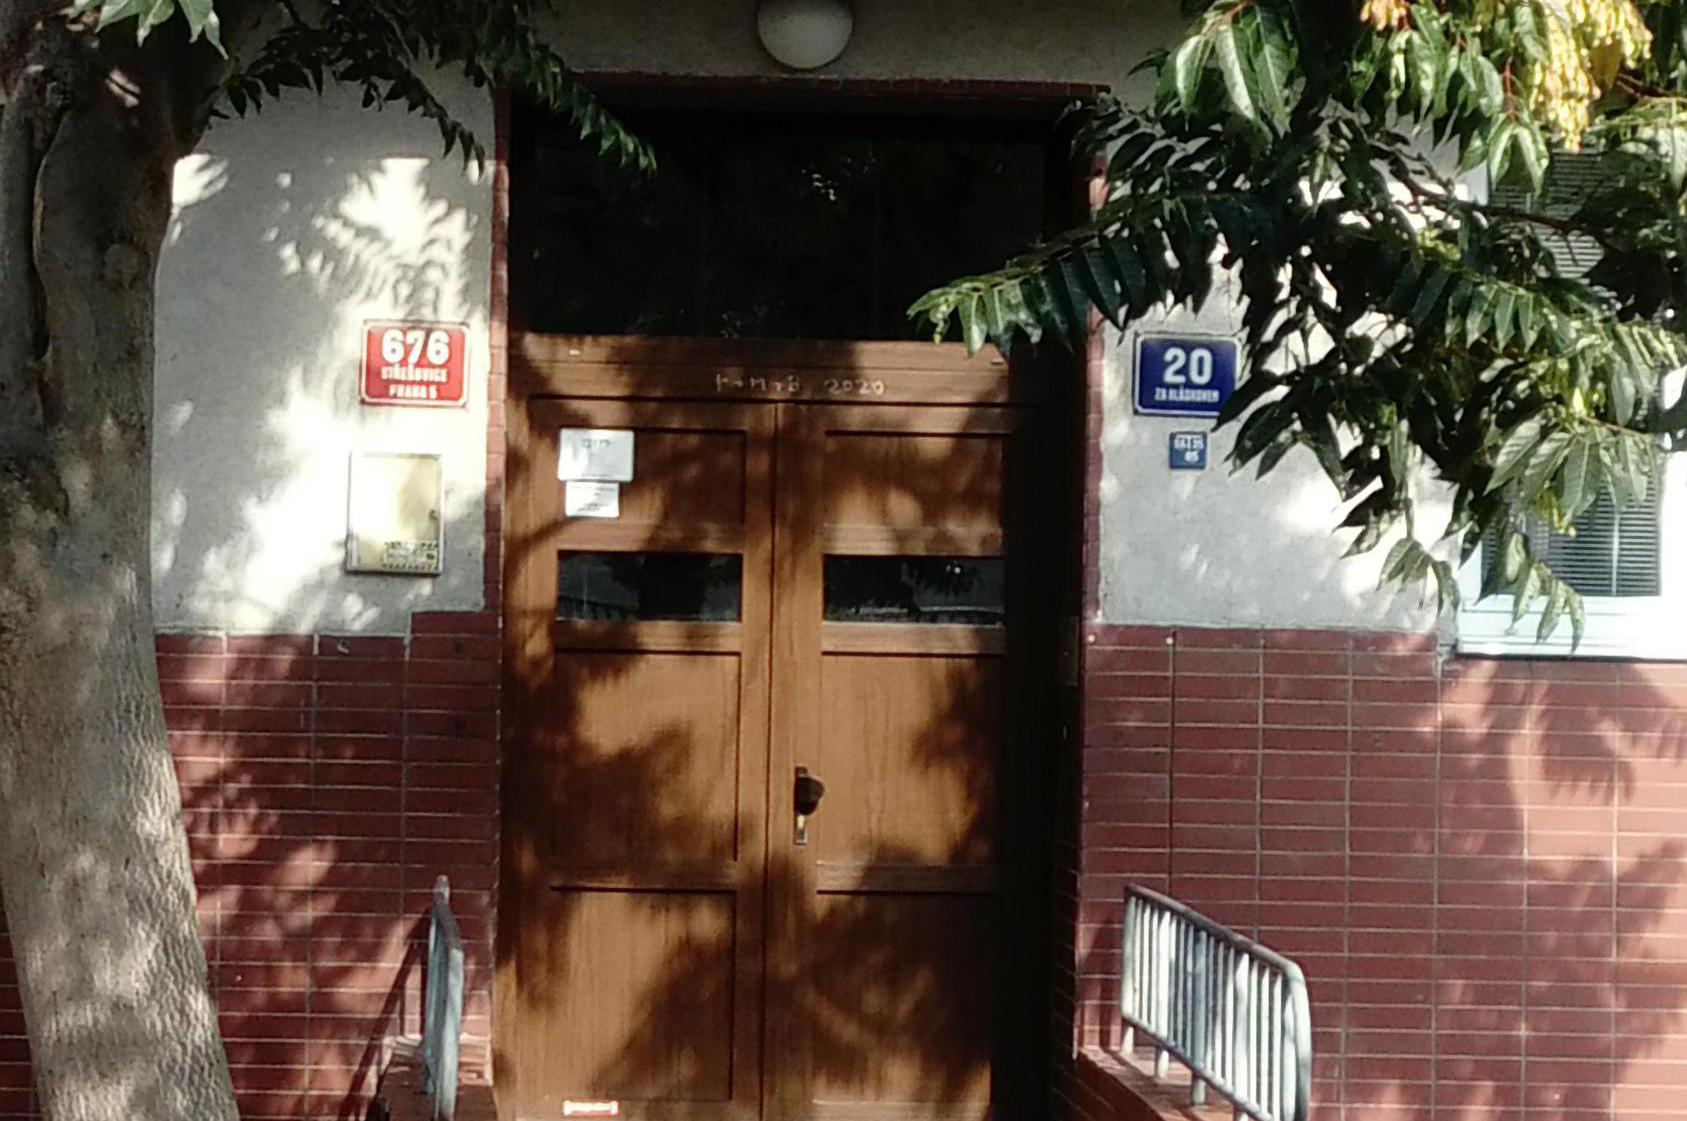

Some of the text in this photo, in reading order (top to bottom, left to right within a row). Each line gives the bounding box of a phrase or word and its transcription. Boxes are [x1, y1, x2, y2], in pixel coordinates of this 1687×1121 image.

[382, 328, 450, 366] 676
[1162, 347, 1213, 385] 20
[388, 384, 428, 399] PRAHA
[824, 377, 885, 396] 2020
